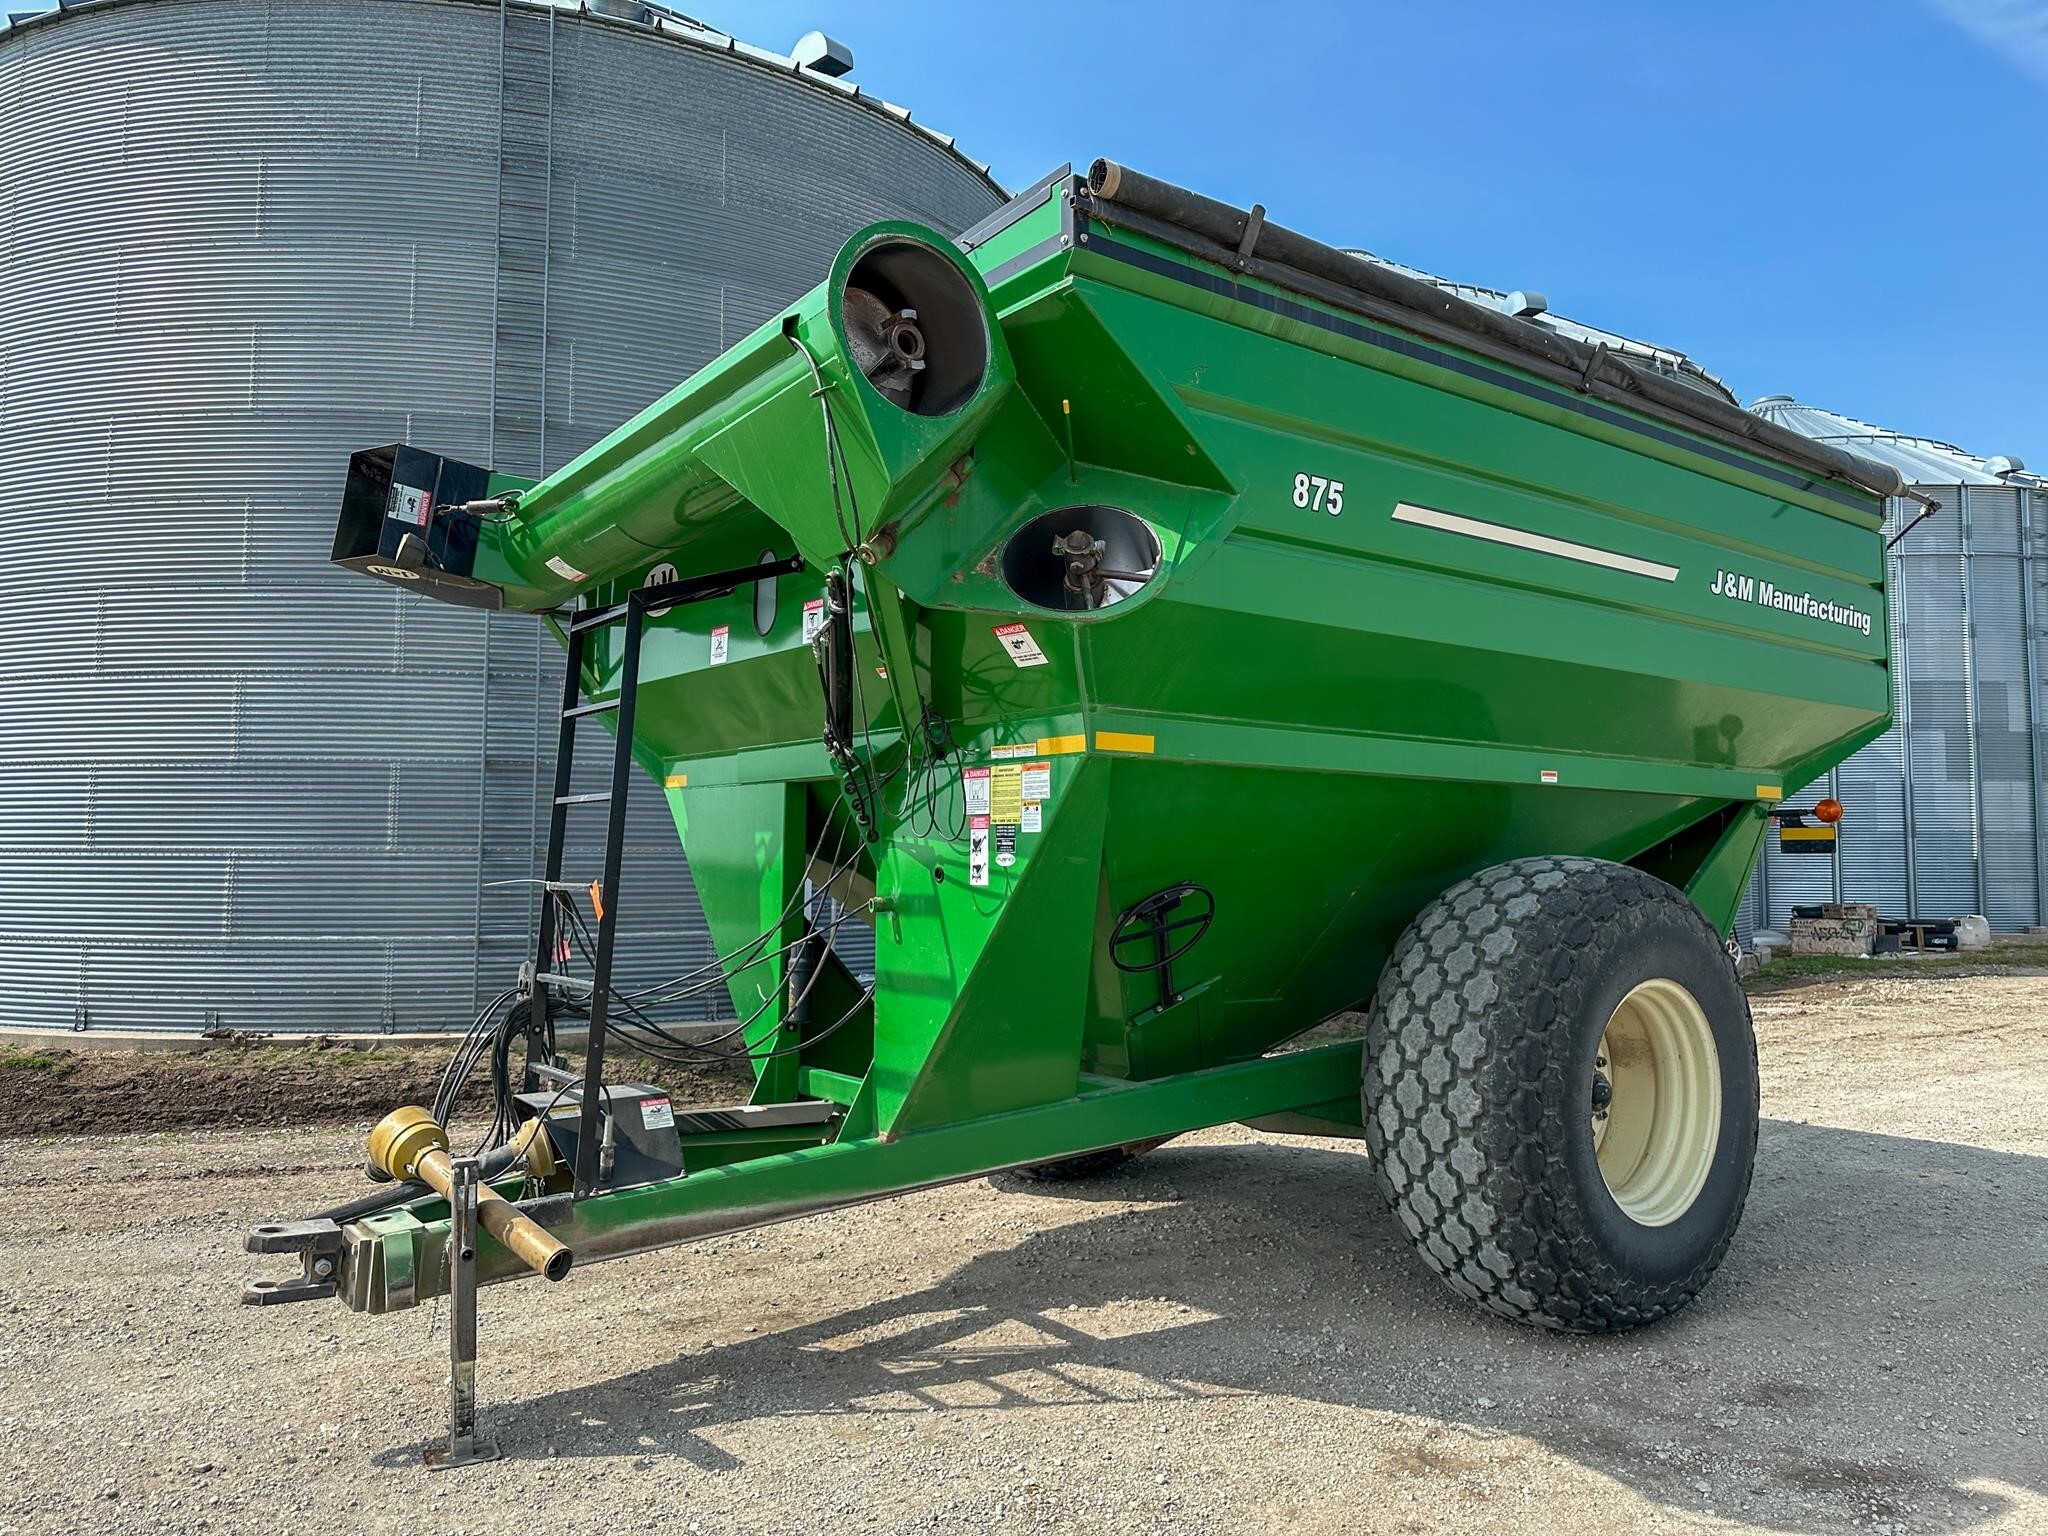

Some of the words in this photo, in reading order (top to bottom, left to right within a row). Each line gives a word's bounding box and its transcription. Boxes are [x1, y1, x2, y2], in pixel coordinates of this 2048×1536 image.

[1293, 472, 1344, 516] 875
[418, 497, 431, 526] DANGER
[1711, 569, 1754, 603] J&M
[1758, 580, 1872, 637] Manufacturing
[1000, 624, 1026, 635] DANGER
[970, 769, 990, 777] DANGER
